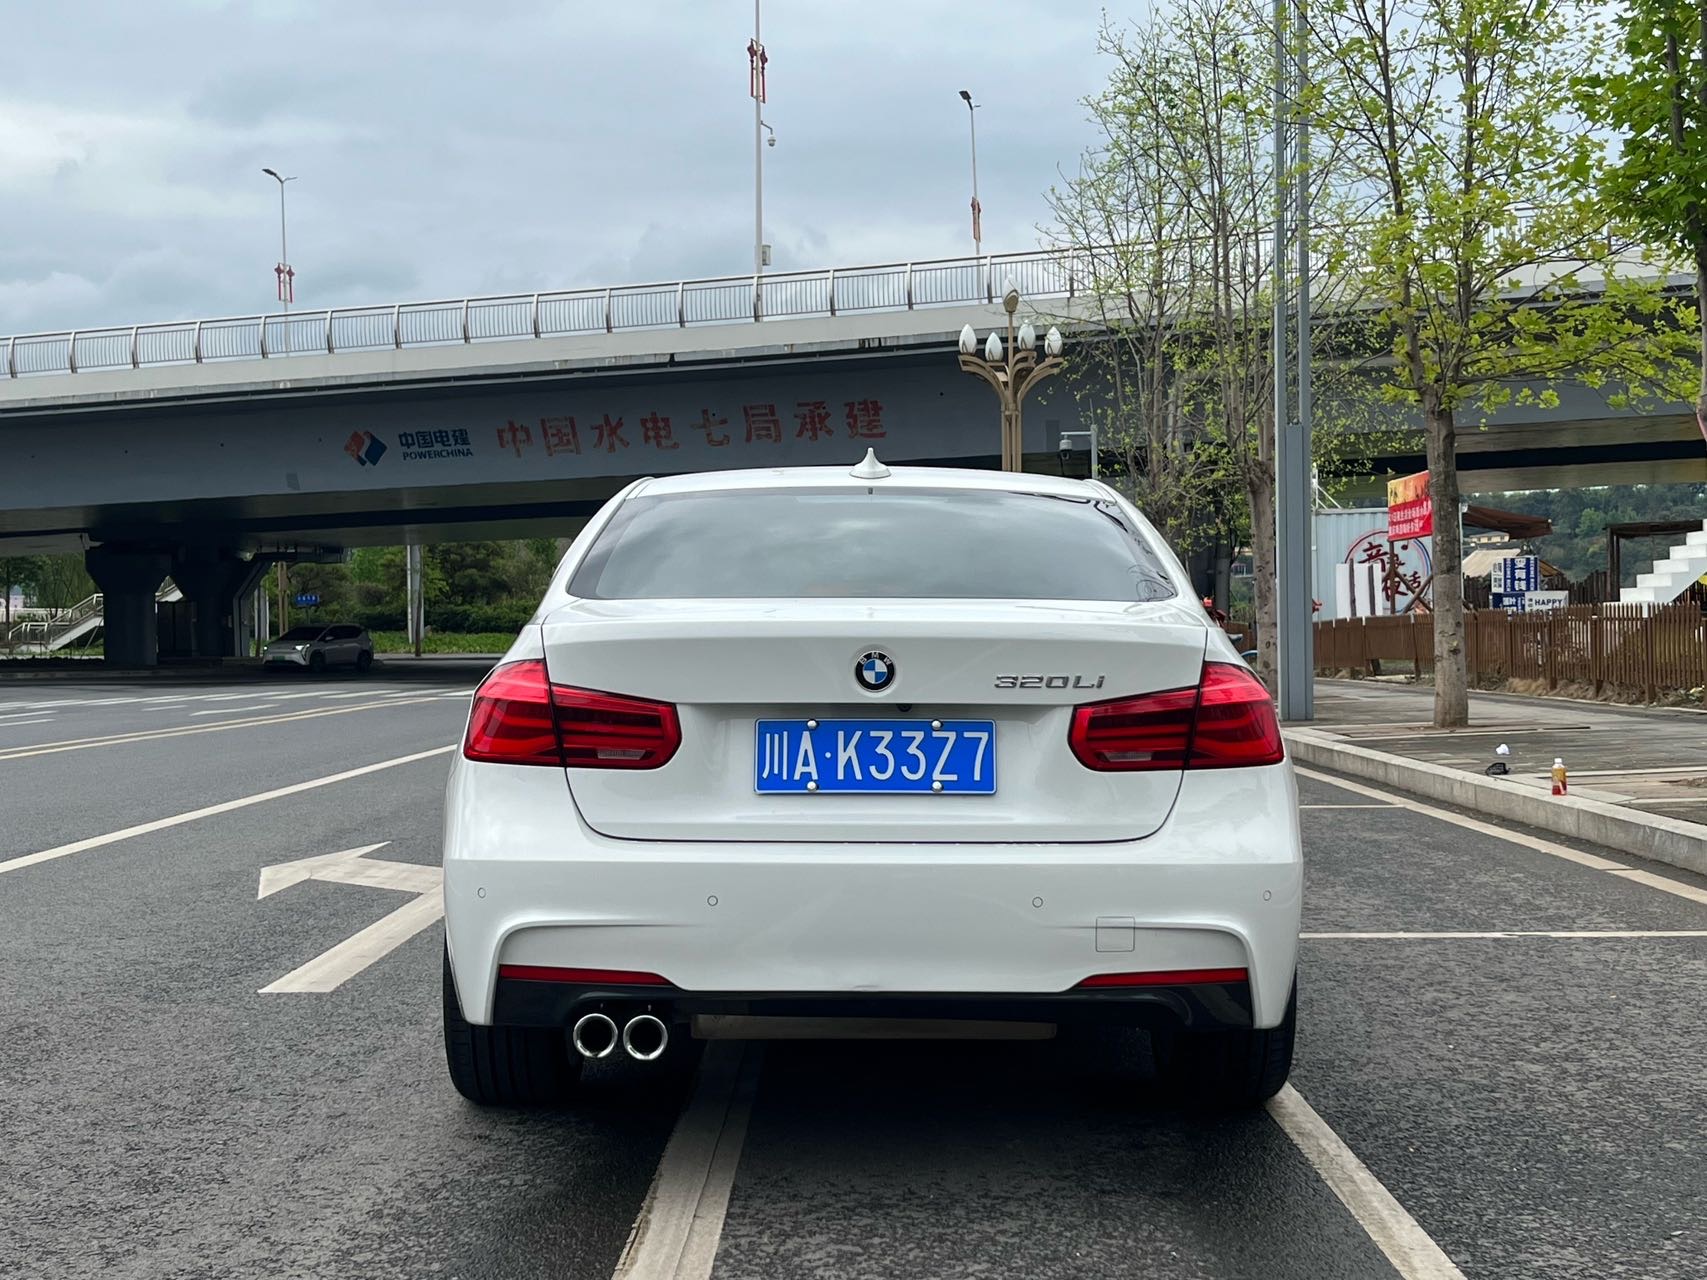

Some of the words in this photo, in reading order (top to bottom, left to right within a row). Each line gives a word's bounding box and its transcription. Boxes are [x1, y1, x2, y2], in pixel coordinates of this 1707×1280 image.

[496, 399, 888, 458] 中国水电七局承建
[398, 429, 472, 449] 中国电建
[402, 448, 473, 460] POWERCHINA
[1534, 598, 1563, 606] HAPPY
[994, 674, 1105, 689] 320Li
